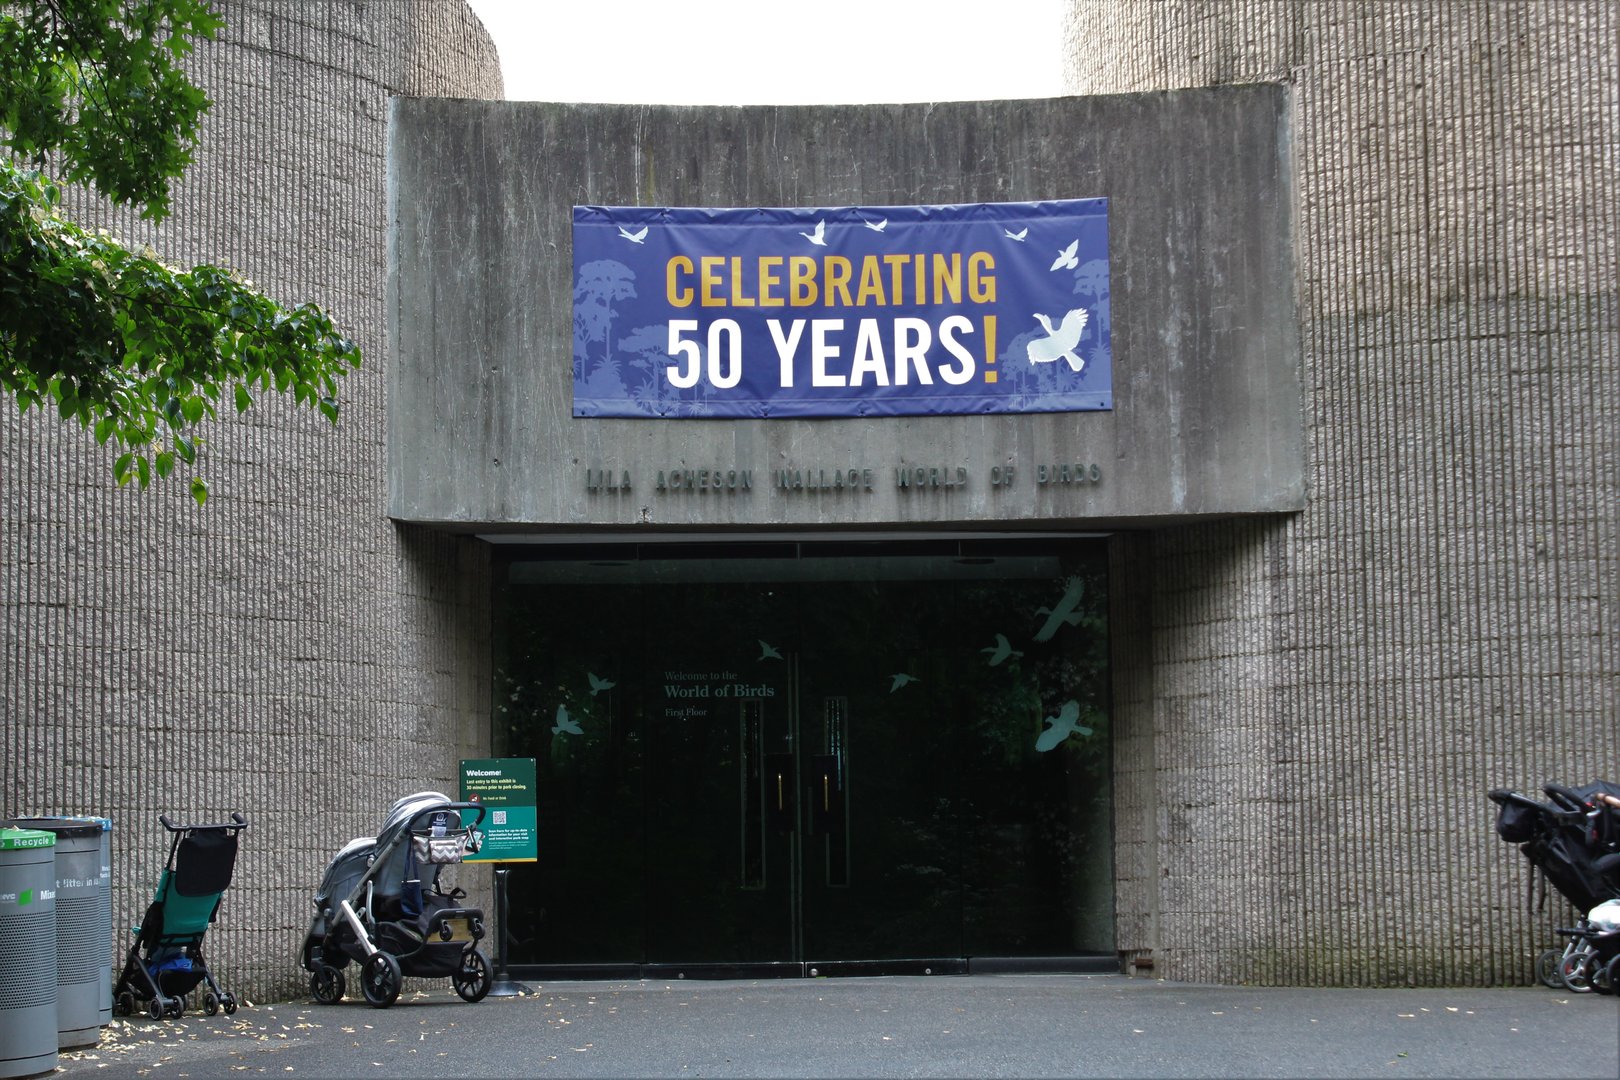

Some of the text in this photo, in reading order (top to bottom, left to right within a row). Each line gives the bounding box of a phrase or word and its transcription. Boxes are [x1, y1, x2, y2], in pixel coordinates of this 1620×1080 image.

[665, 251, 997, 308] CELEBRATING
[666, 314, 998, 389] 50 YEARS!
[586, 463, 1100, 489] LILA ACHESON WALLACE WORLD OF BIRDS
[664, 671, 738, 681] Welcome to the
[664, 684, 775, 698] World of Birds
[665, 708, 708, 717] First Floor
[466, 769, 502, 777] Welcome!
[13, 836, 50, 847] Recycle
